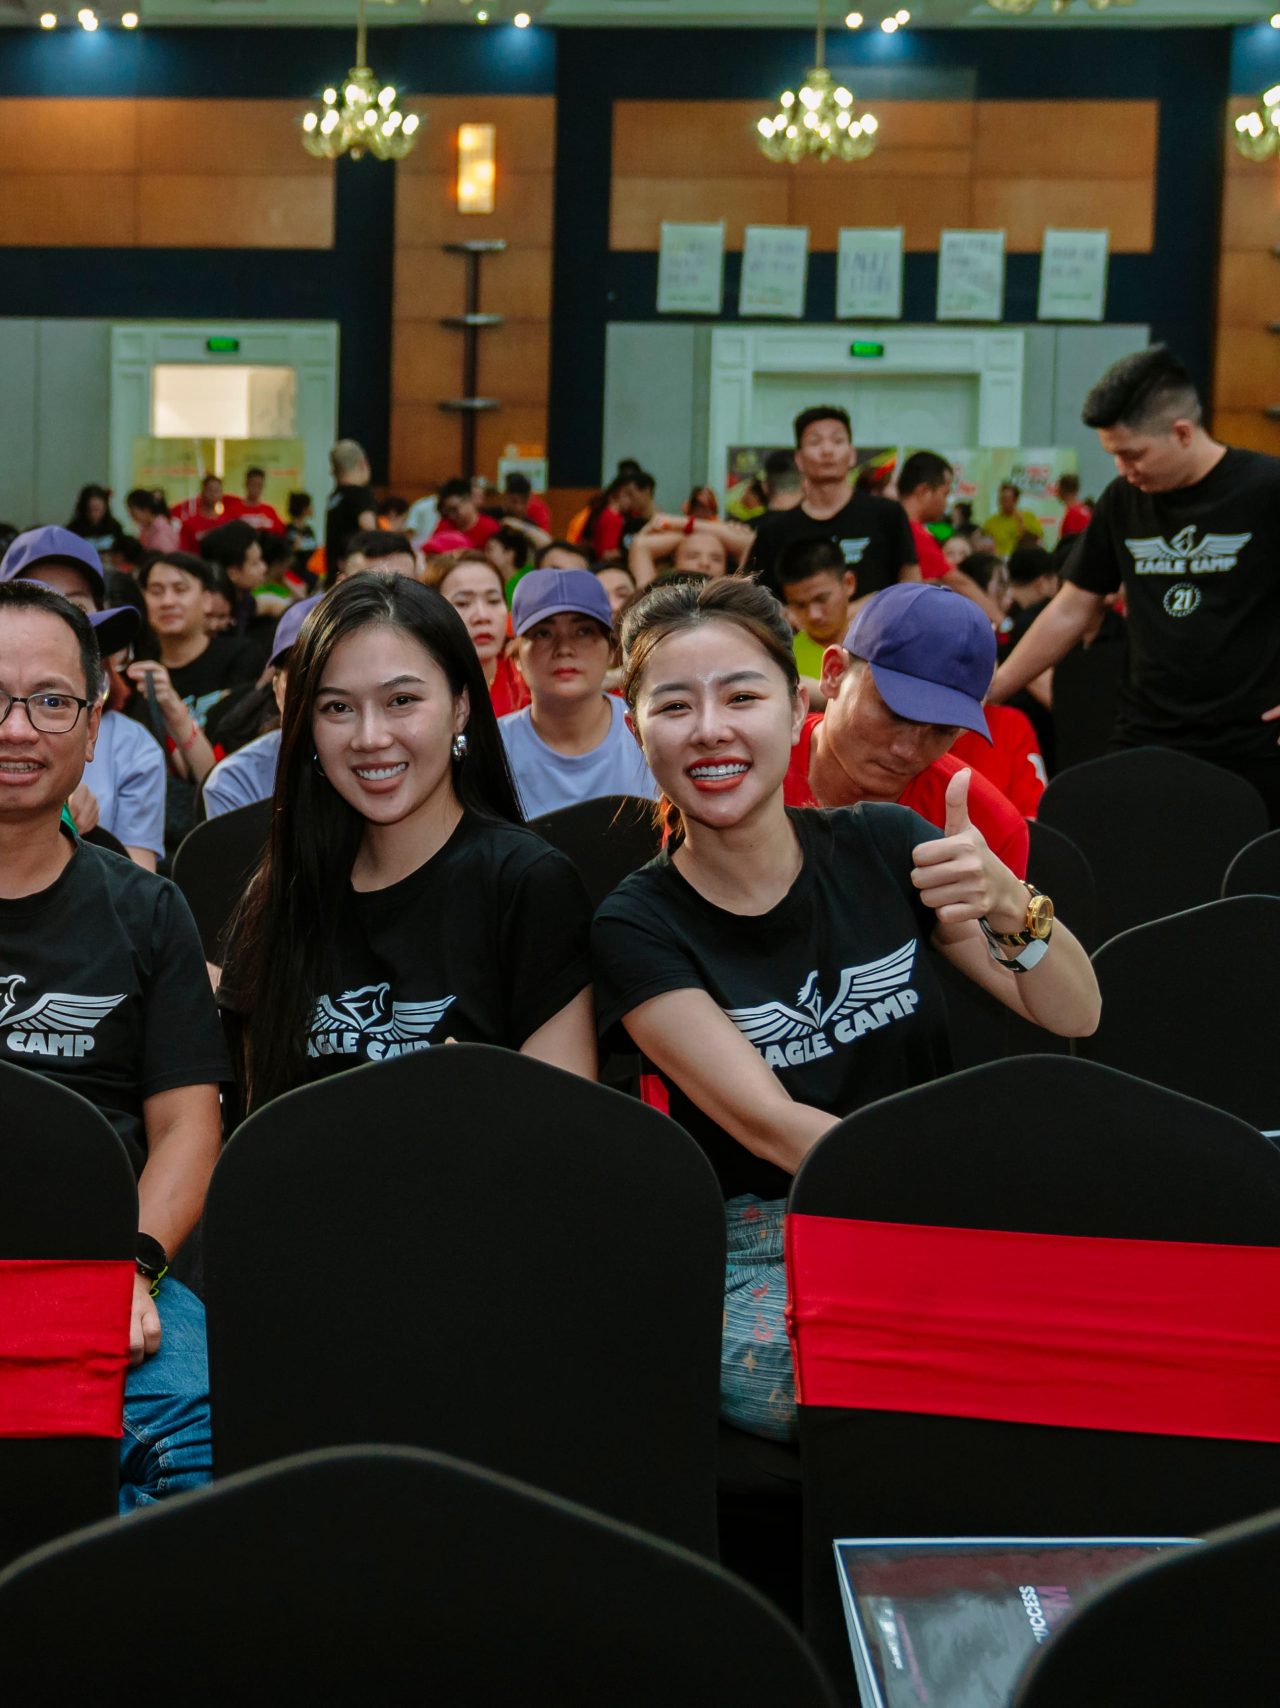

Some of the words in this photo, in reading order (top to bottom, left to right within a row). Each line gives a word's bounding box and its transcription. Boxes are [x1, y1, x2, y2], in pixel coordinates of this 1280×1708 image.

[1135, 558, 1187, 575] EAGLE
[1189, 556, 1238, 574] CAMP
[1172, 588, 1194, 611] 21
[758, 1031, 834, 1069] AGLE
[834, 989, 919, 1044] CAMP
[6, 1032, 96, 1058] CAMP
[307, 1031, 360, 1058] AGLE
[1018, 1585, 1050, 1644] UCCESS
